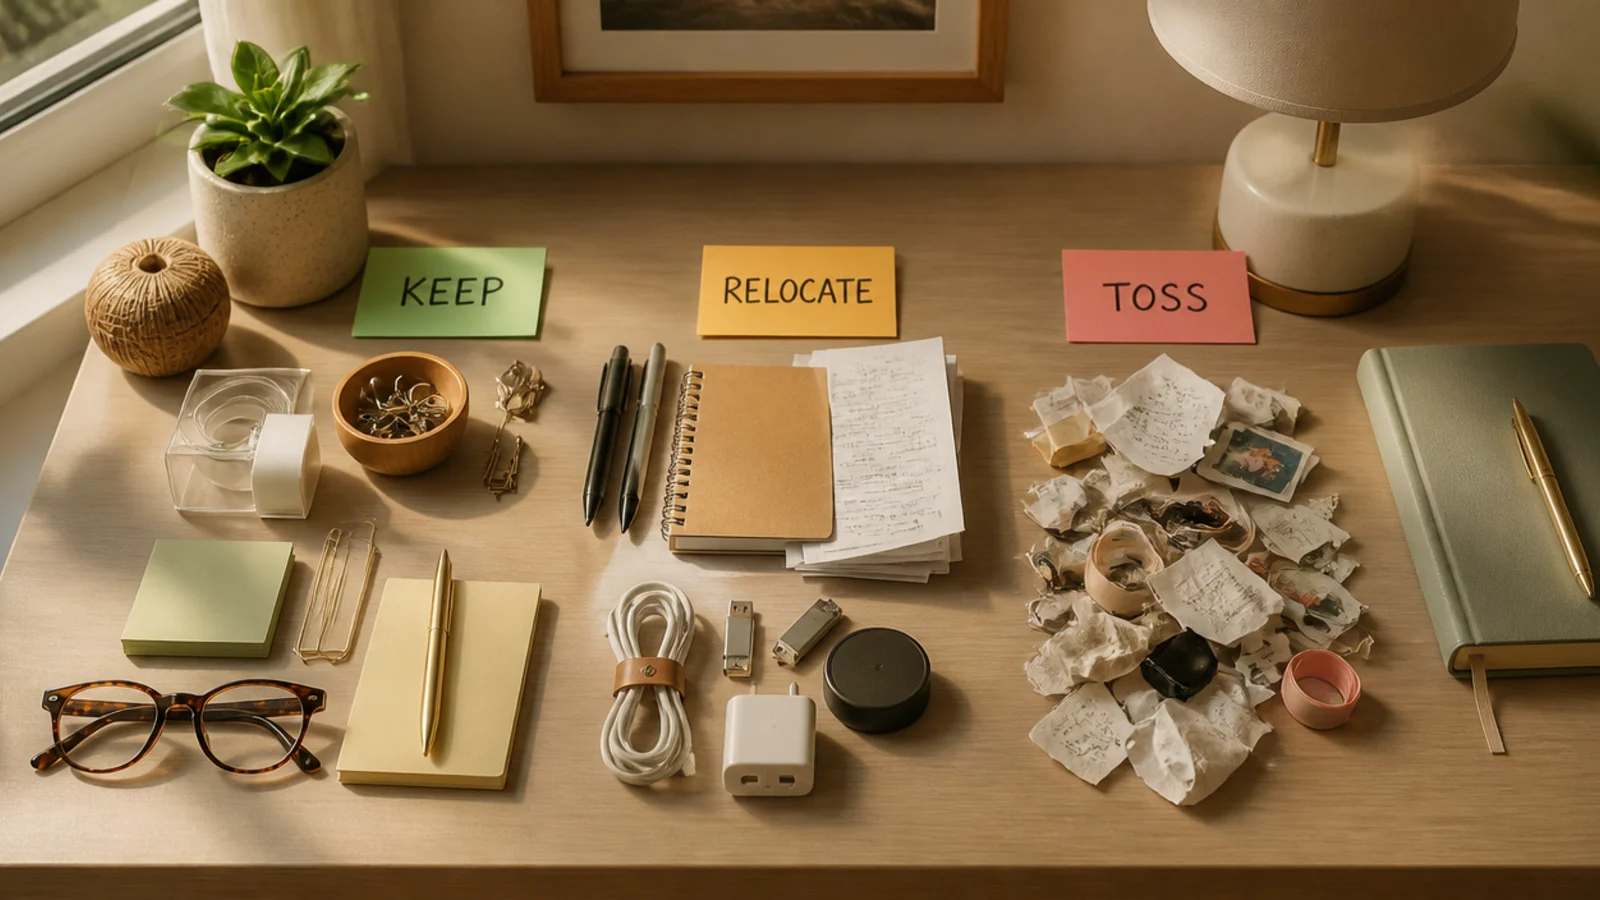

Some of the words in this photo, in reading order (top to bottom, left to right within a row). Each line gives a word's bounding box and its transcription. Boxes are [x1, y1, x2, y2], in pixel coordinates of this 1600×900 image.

[400, 276, 504, 308] KEEP
[724, 276, 873, 305] RELOCATE
[1103, 282, 1208, 313] TOSS
